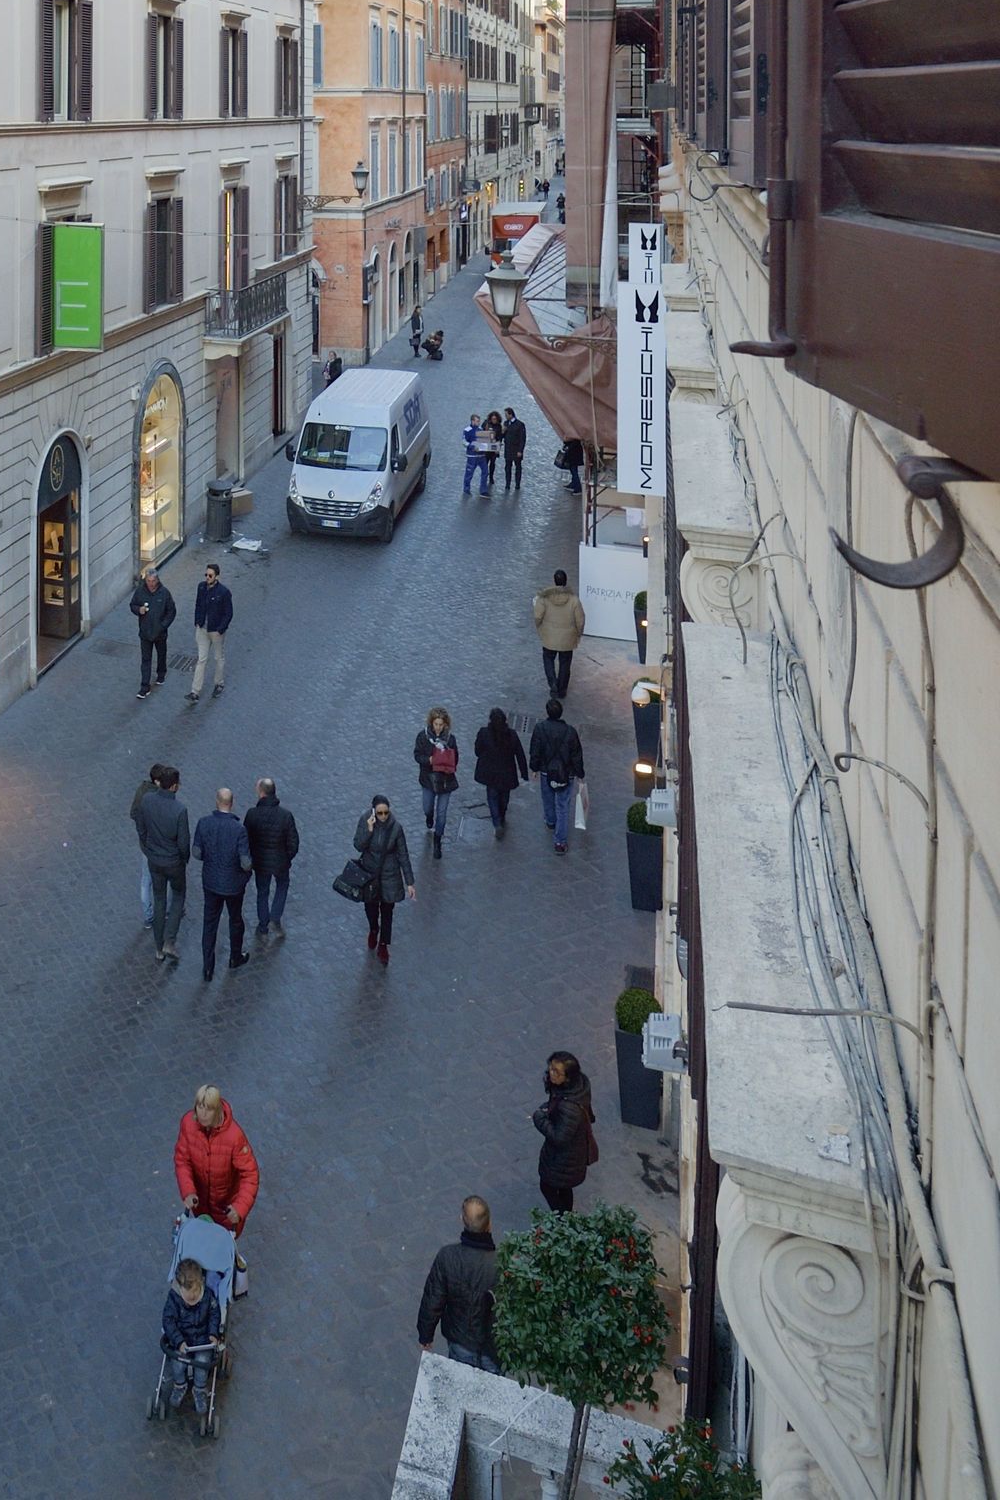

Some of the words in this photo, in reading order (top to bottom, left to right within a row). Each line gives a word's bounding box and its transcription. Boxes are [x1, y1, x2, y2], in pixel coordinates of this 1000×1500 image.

[56, 281, 89, 332] E
[641, 326, 653, 490] MORESCHI
[586, 585, 622, 599] PATRIZIA
